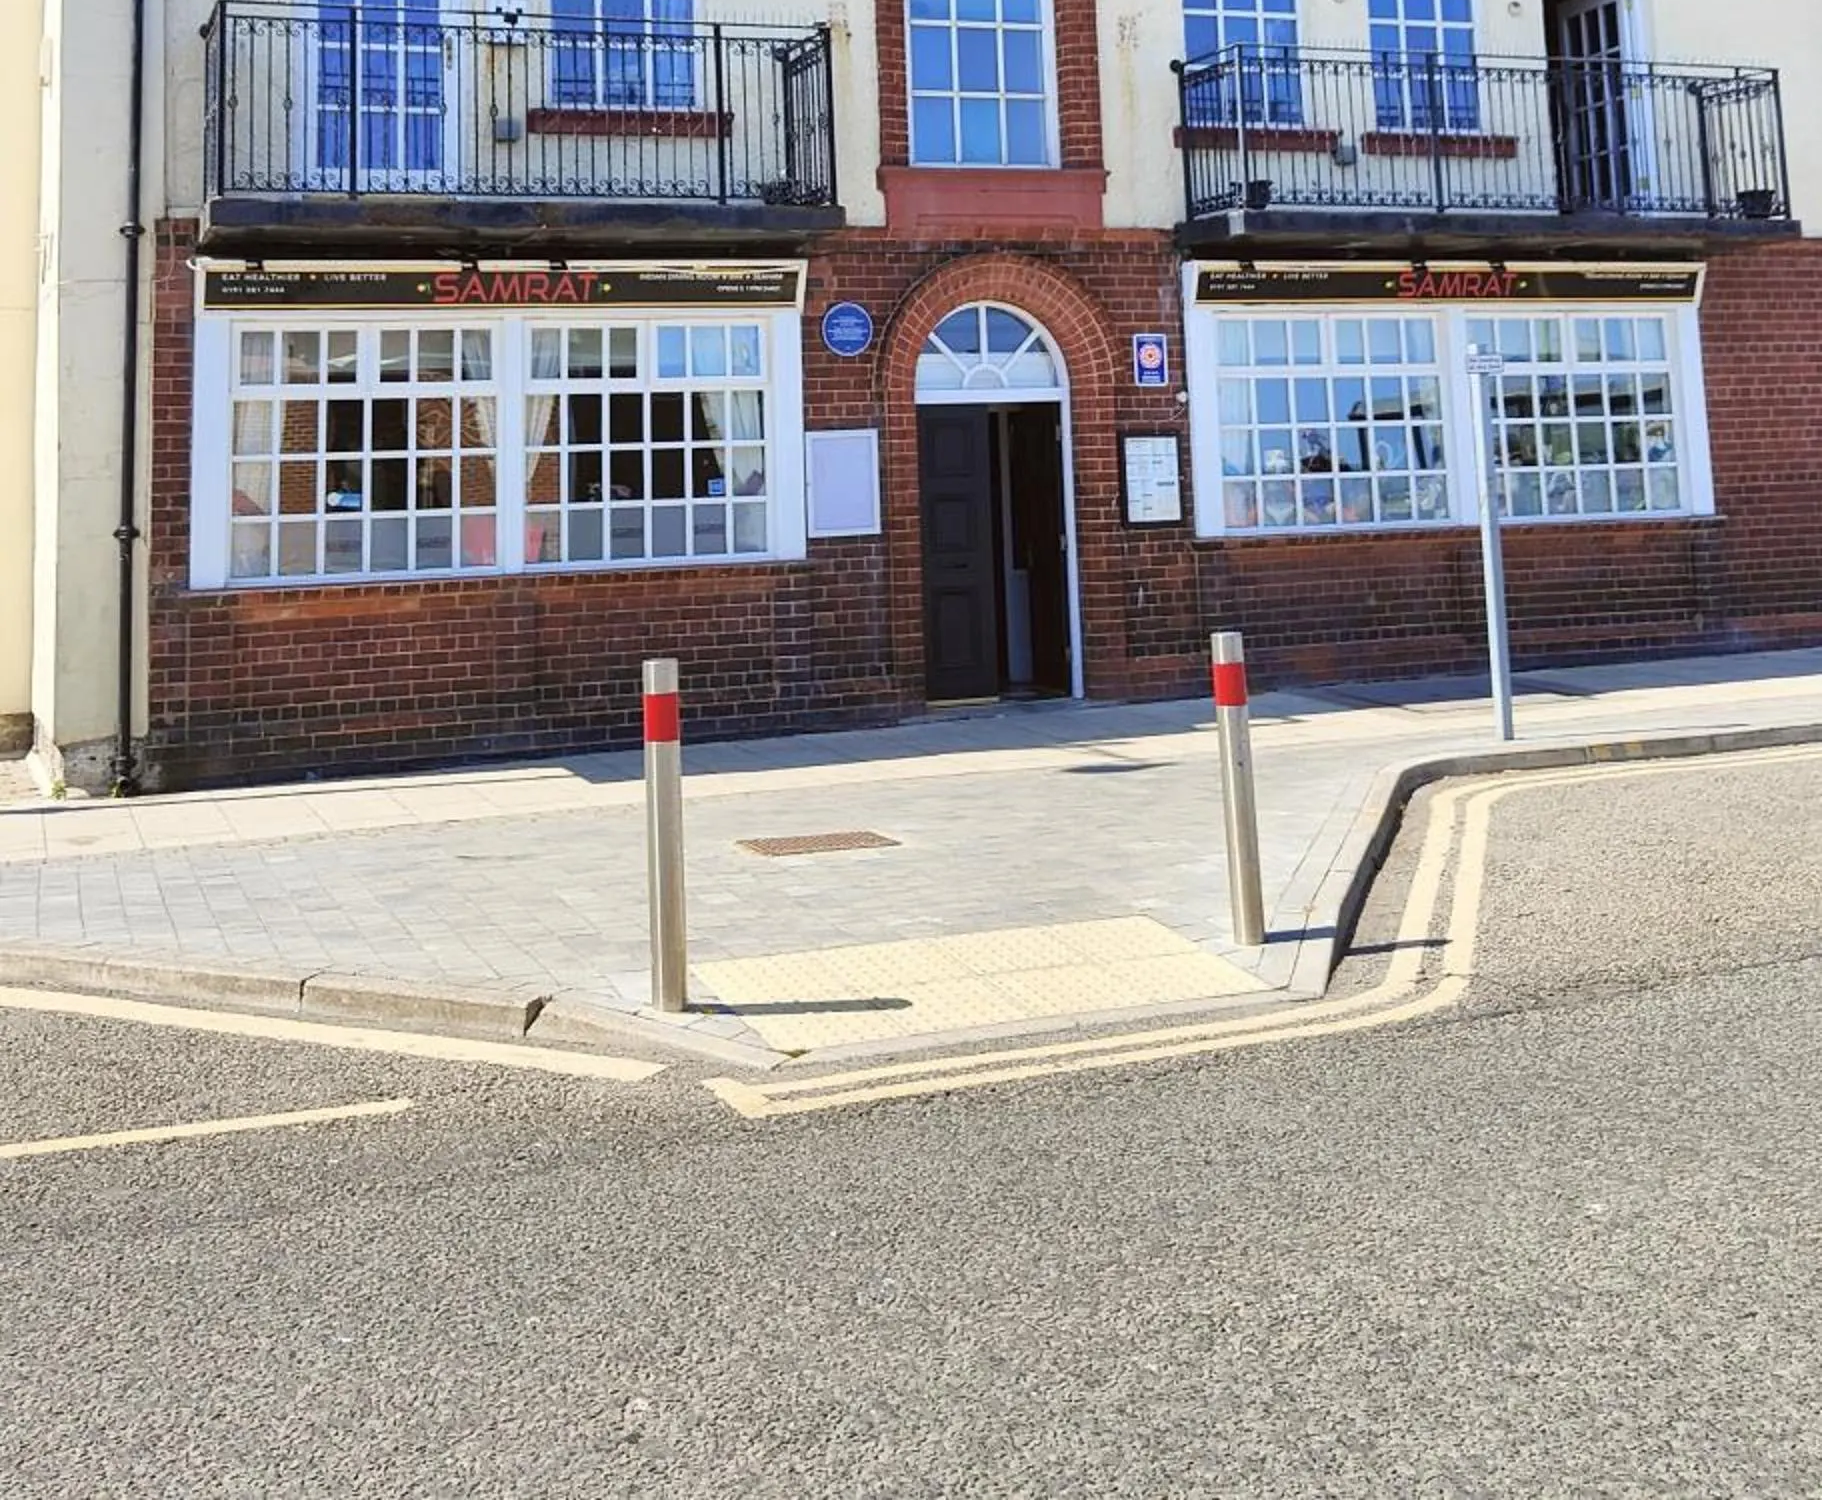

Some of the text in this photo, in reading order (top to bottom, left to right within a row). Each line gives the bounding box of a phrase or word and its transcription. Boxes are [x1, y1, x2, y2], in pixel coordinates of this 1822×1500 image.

[349, 273, 387, 281] BETTER
[434, 272, 598, 303] SAMRAT
[1398, 272, 1518, 297] SAMRAT
